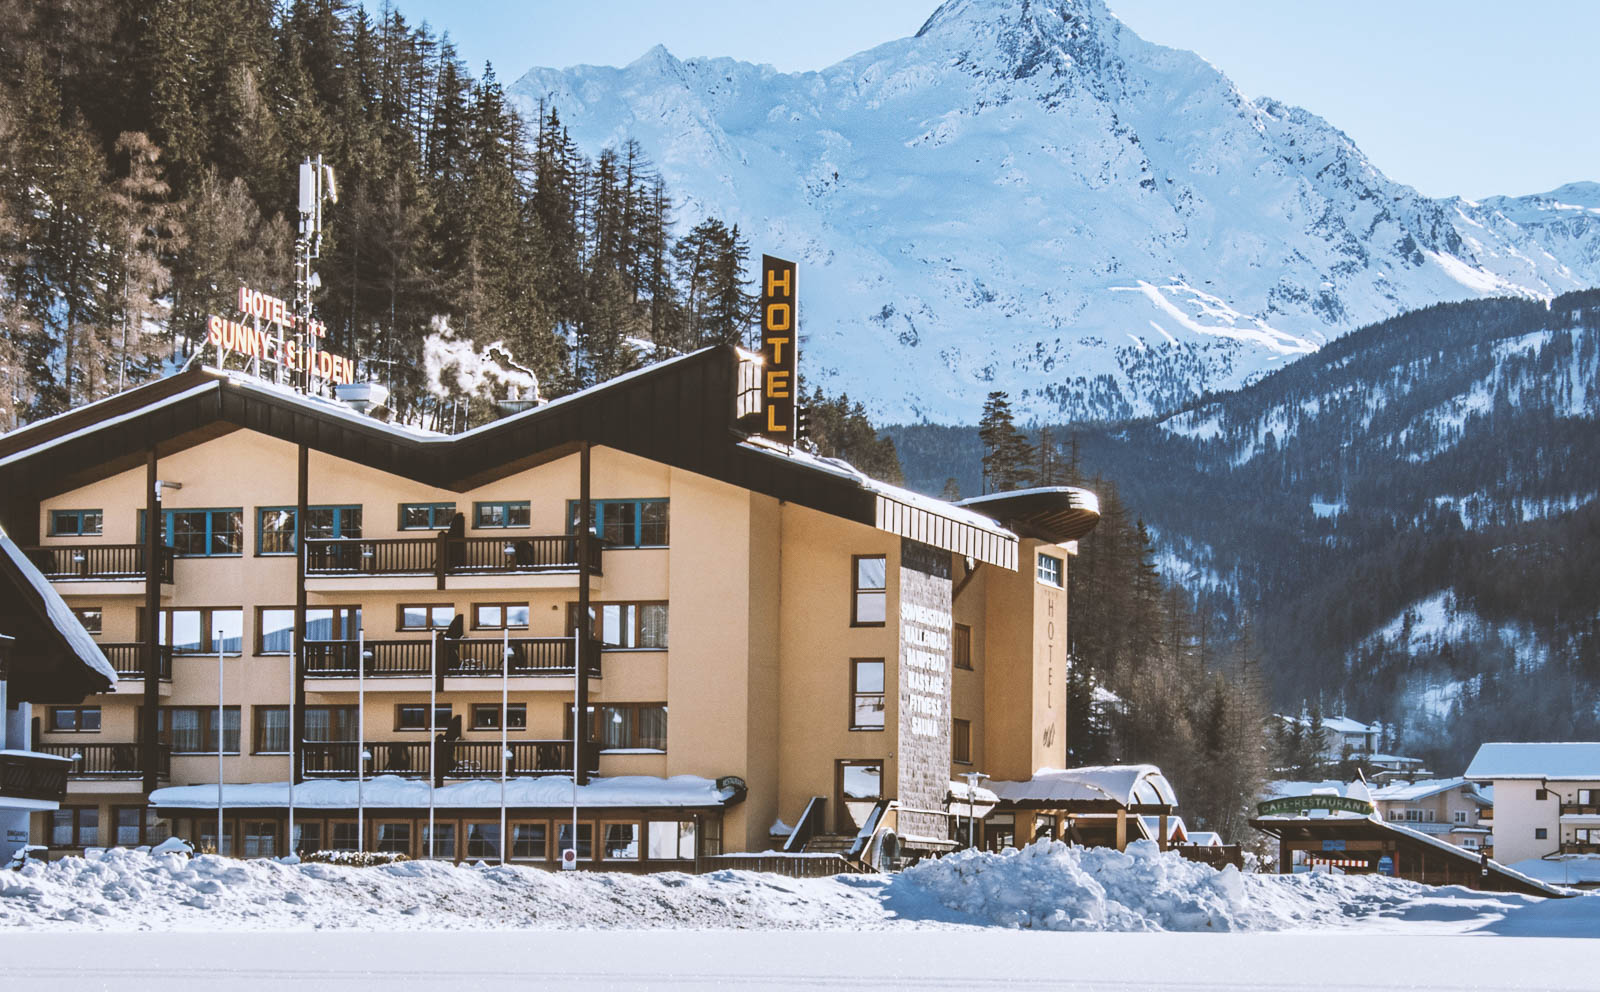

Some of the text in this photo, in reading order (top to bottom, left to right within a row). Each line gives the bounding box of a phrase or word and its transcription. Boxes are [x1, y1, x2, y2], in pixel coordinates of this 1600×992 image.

[239, 287, 295, 328] HOTEL
[208, 315, 272, 360] SUNNY
[766, 269, 791, 432] HOTEL
[1047, 598, 1055, 709] HOTEL
[908, 671, 944, 695] MASSAGE
[909, 694, 942, 717] FITNESS
[911, 716, 938, 737] SAUNA
